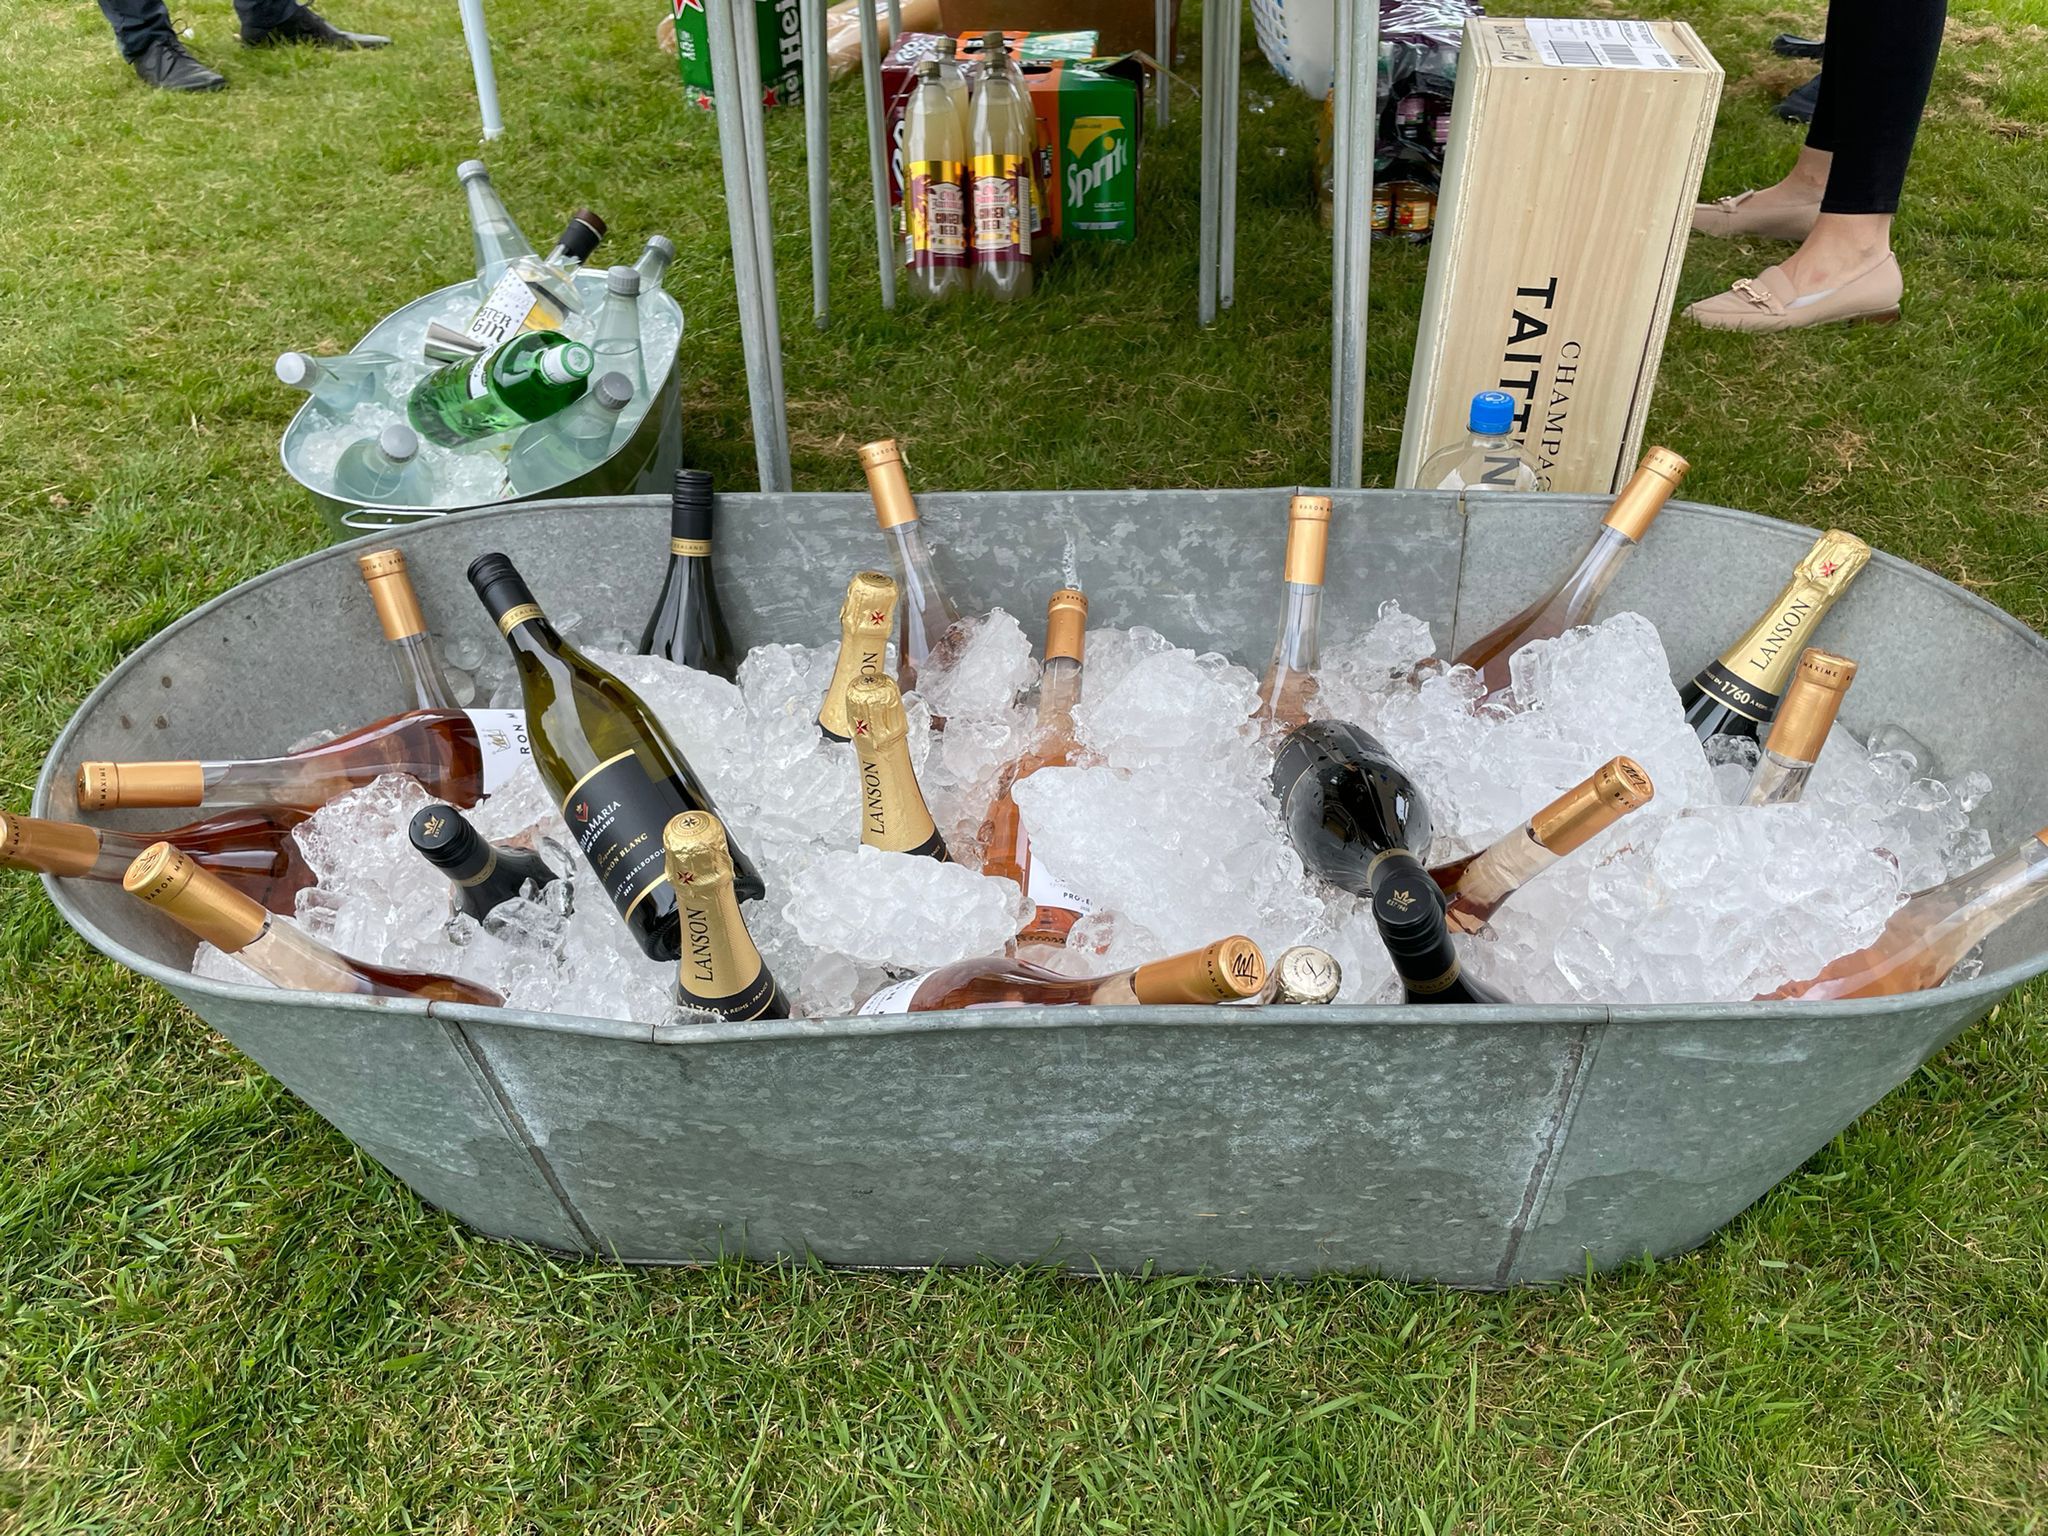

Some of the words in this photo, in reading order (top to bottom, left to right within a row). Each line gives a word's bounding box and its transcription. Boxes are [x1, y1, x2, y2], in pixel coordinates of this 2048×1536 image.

[1481, 277, 1558, 485] TAITTN
[1749, 598, 1811, 670] LANSON
[1803, 662, 1838, 678] MAXIME
[1720, 681, 1751, 704] 1760
[862, 761, 885, 836] LANSON
[588, 801, 622, 832] MARIA
[591, 816, 615, 841] ZEALAND
[619, 833, 648, 858] BLANC
[686, 907, 714, 982] LANSON
